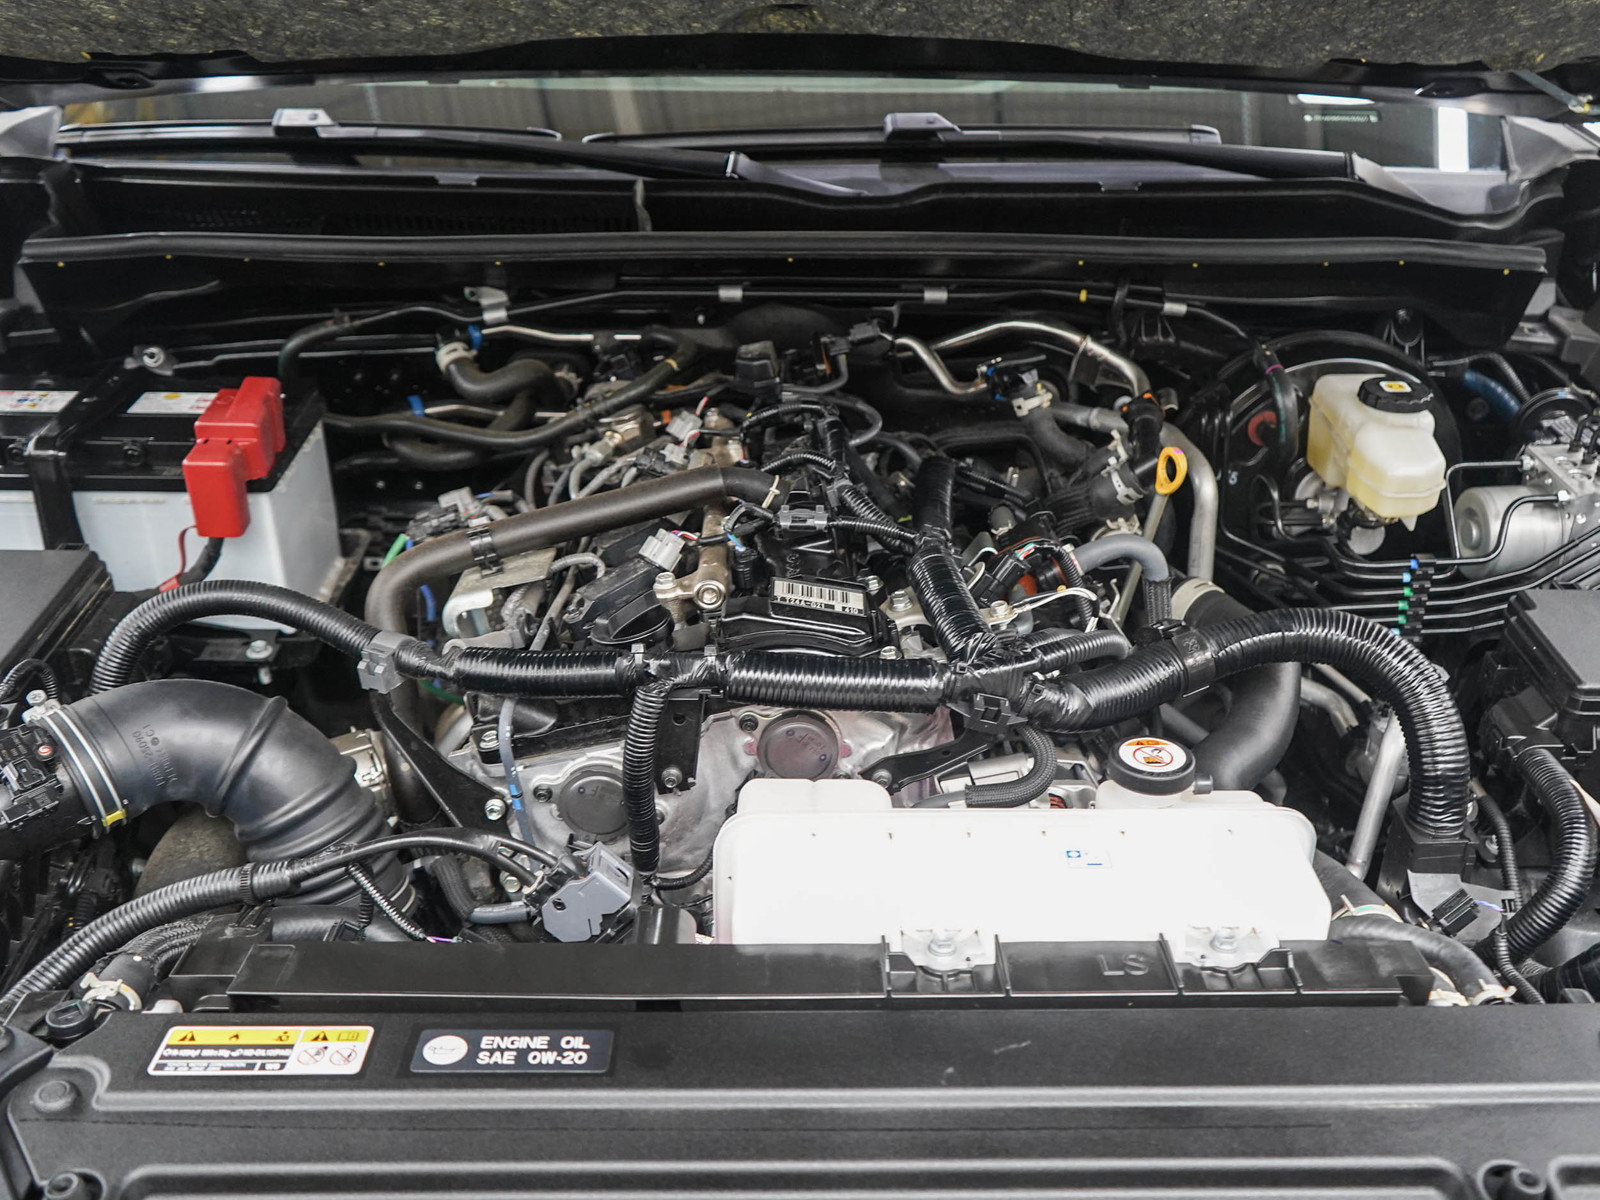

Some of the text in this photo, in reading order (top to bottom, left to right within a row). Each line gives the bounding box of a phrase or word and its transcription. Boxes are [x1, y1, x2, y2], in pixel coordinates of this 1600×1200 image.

[1096, 953, 1149, 976] LS
[480, 1036, 591, 1049] ENGINE OIL
[476, 1051, 588, 1065] SAE 0W-20
